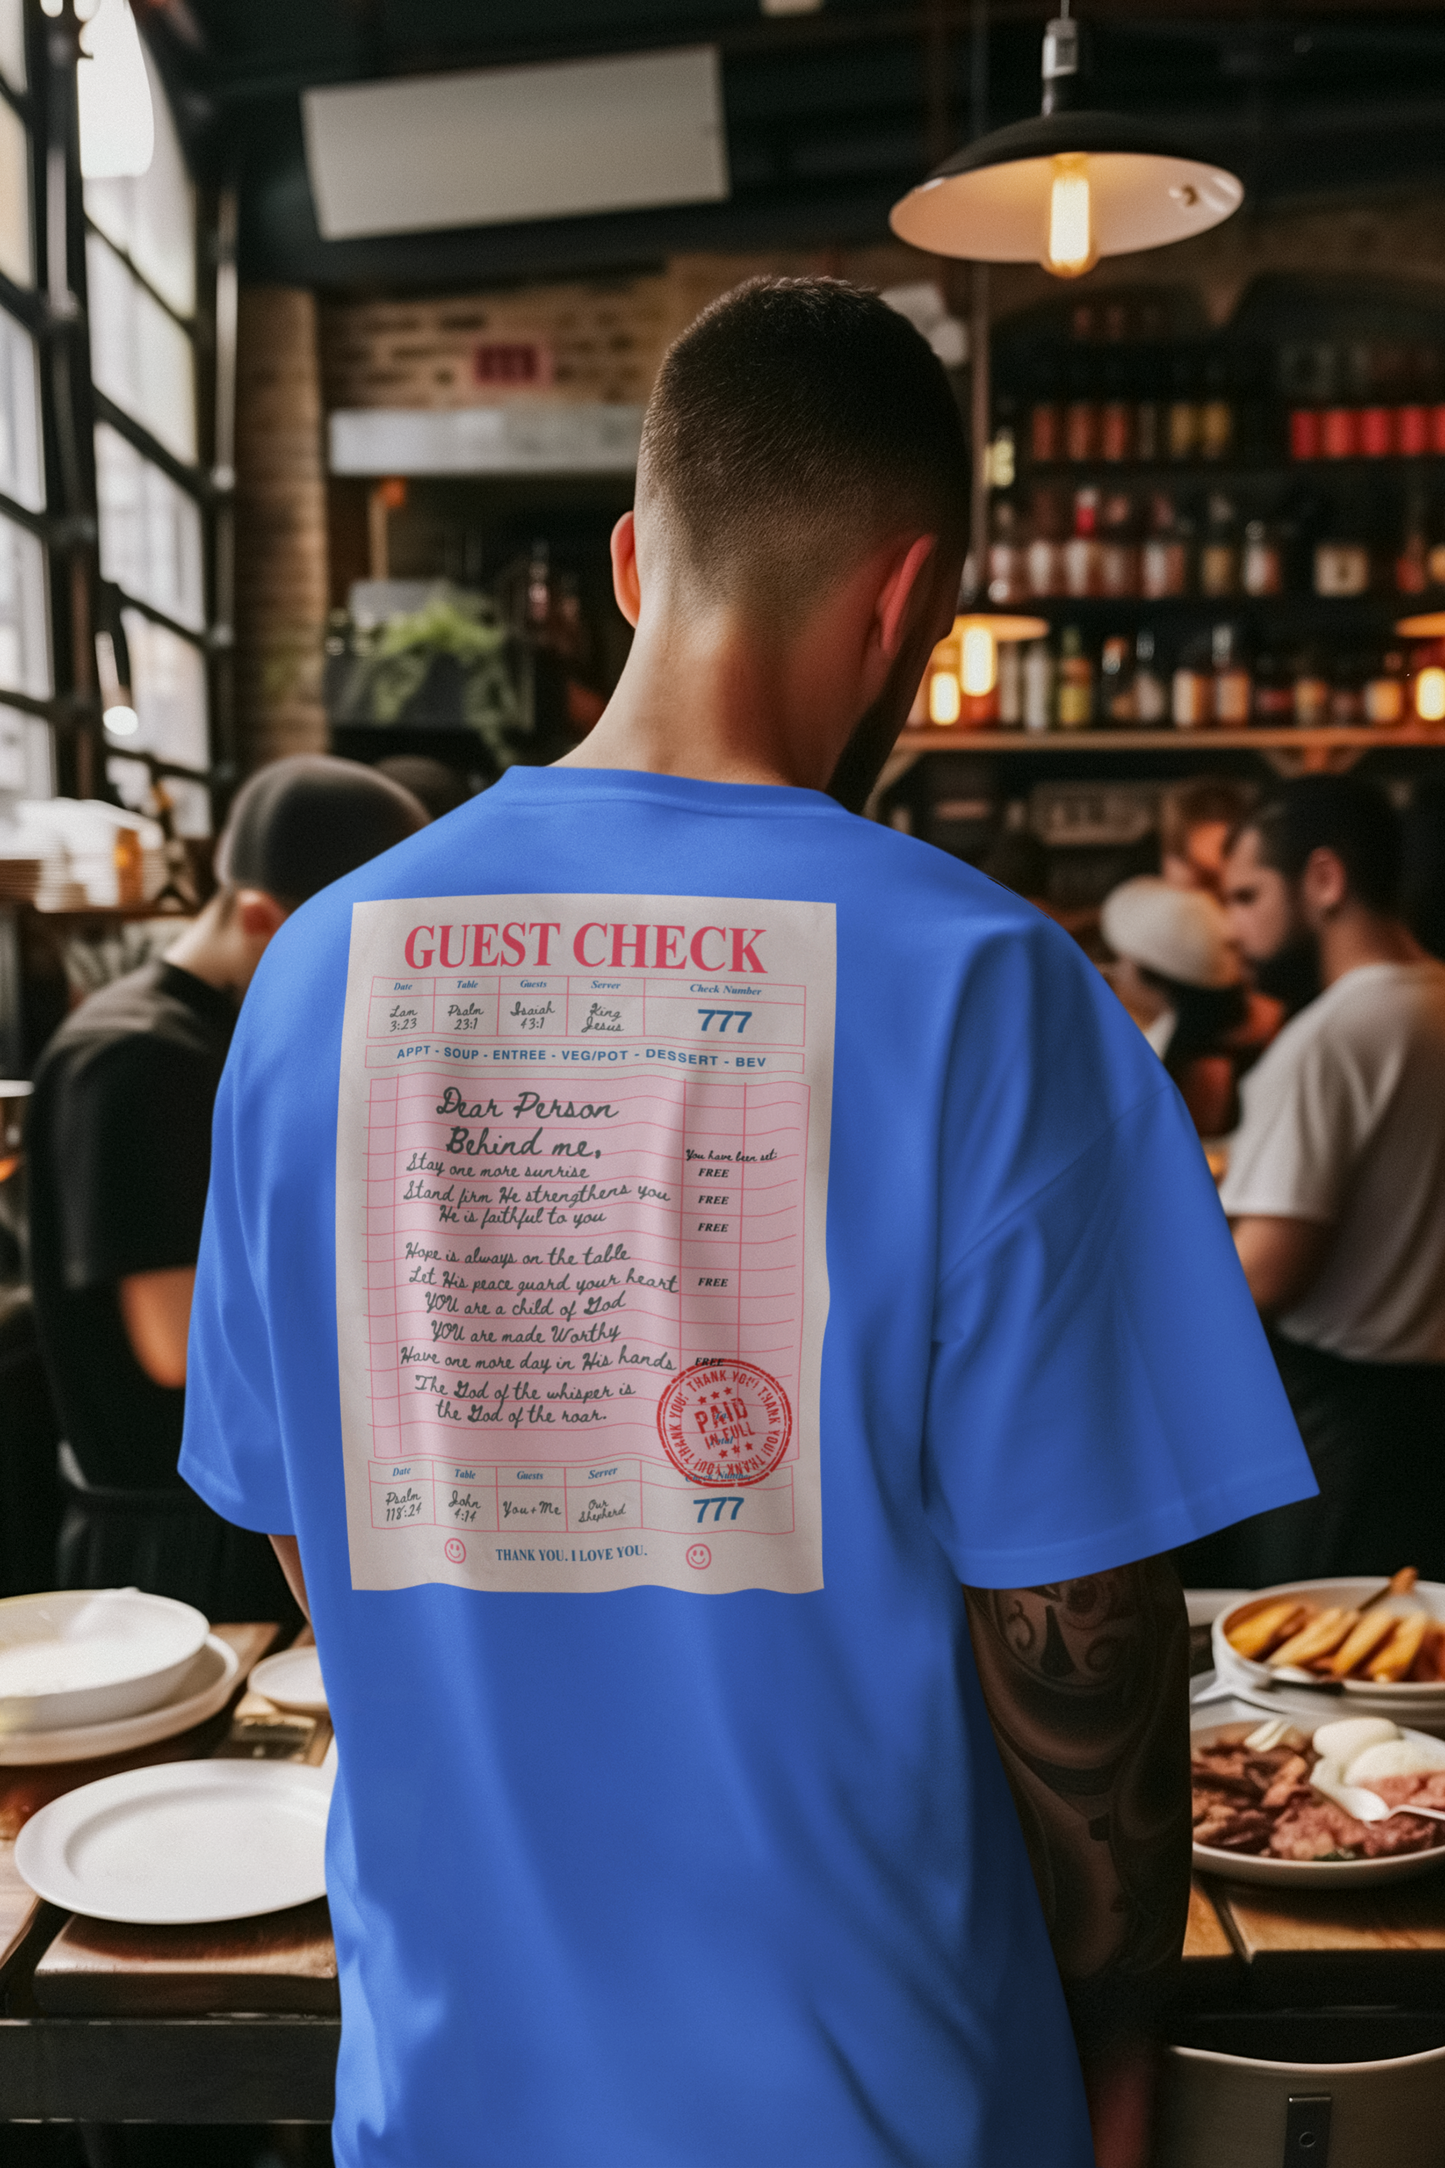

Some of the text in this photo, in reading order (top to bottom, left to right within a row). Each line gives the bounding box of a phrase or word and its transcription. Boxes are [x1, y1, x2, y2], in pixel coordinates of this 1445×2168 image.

[404, 922, 768, 974] GUEST CHECK
[394, 982, 412, 991] Date
[457, 980, 478, 989] Table
[520, 980, 547, 988] Guests
[591, 980, 621, 990] Server
[690, 984, 762, 996] Check Number
[390, 1005, 417, 1017] Lam
[448, 1003, 484, 1017] Psalm
[510, 1001, 555, 1016] Isaiah
[590, 1003, 622, 1021] King
[390, 1018, 417, 1032] 3:23
[454, 1018, 478, 1030] 23:1
[520, 1017, 545, 1029] 43:1
[581, 1016, 624, 1033] Jesus
[698, 1009, 752, 1033] 777
[397, 1046, 431, 1059] APPT
[444, 1047, 479, 1059] SOUP
[493, 1050, 546, 1060] ENTREE
[562, 1050, 628, 1061] VEG/POT
[646, 1049, 718, 1066] DESSERT
[736, 1057, 766, 1067] BEV
[436, 1087, 618, 1119] Dear Person
[446, 1126, 543, 1155] Behind
[686, 1149, 705, 1161] You
[708, 1150, 733, 1161] have
[736, 1151, 757, 1162] been
[406, 1152, 589, 1178] Stay one more sunrise
[698, 1168, 729, 1178] FREE
[403, 1180, 671, 1209] Stand firm He strengthens you
[698, 1195, 729, 1205] FREE
[439, 1205, 606, 1229] He is faithful to you
[698, 1223, 729, 1232] FREE
[405, 1242, 630, 1268] Hope is always on the table
[409, 1266, 679, 1296] Let His peace guard your heart
[698, 1277, 728, 1288] FREE
[425, 1291, 626, 1322] YOU are a child of God
[431, 1320, 621, 1343] YOU are made Worthy
[401, 1345, 677, 1373] Have one more day in His hands
[695, 1358, 724, 1366] FREE
[686, 1370, 726, 1392] THANK
[415, 1374, 636, 1410] The God of the whisper is
[436, 1399, 607, 1428] the God of the roar.
[669, 1392, 689, 1418] YOU!
[694, 1398, 748, 1434] PAID
[705, 1422, 755, 1450] IN FULL
[761, 1430, 780, 1457] YOU!
[393, 1467, 411, 1477] Date
[455, 1469, 476, 1479] Table
[516, 1471, 543, 1480] Guests
[588, 1468, 617, 1479] Server
[694, 1458, 720, 1476] YOU!
[385, 1488, 421, 1504] Psalm
[449, 1490, 481, 1508] John
[386, 1502, 422, 1521] 118:24
[578, 1503, 626, 1523] Shepherd
[588, 1499, 609, 1511] Our
[693, 1497, 744, 1523] 777
[454, 1508, 477, 1522] 4:14
[496, 1545, 647, 1561] THANK YOU. I LOVE YOU.
